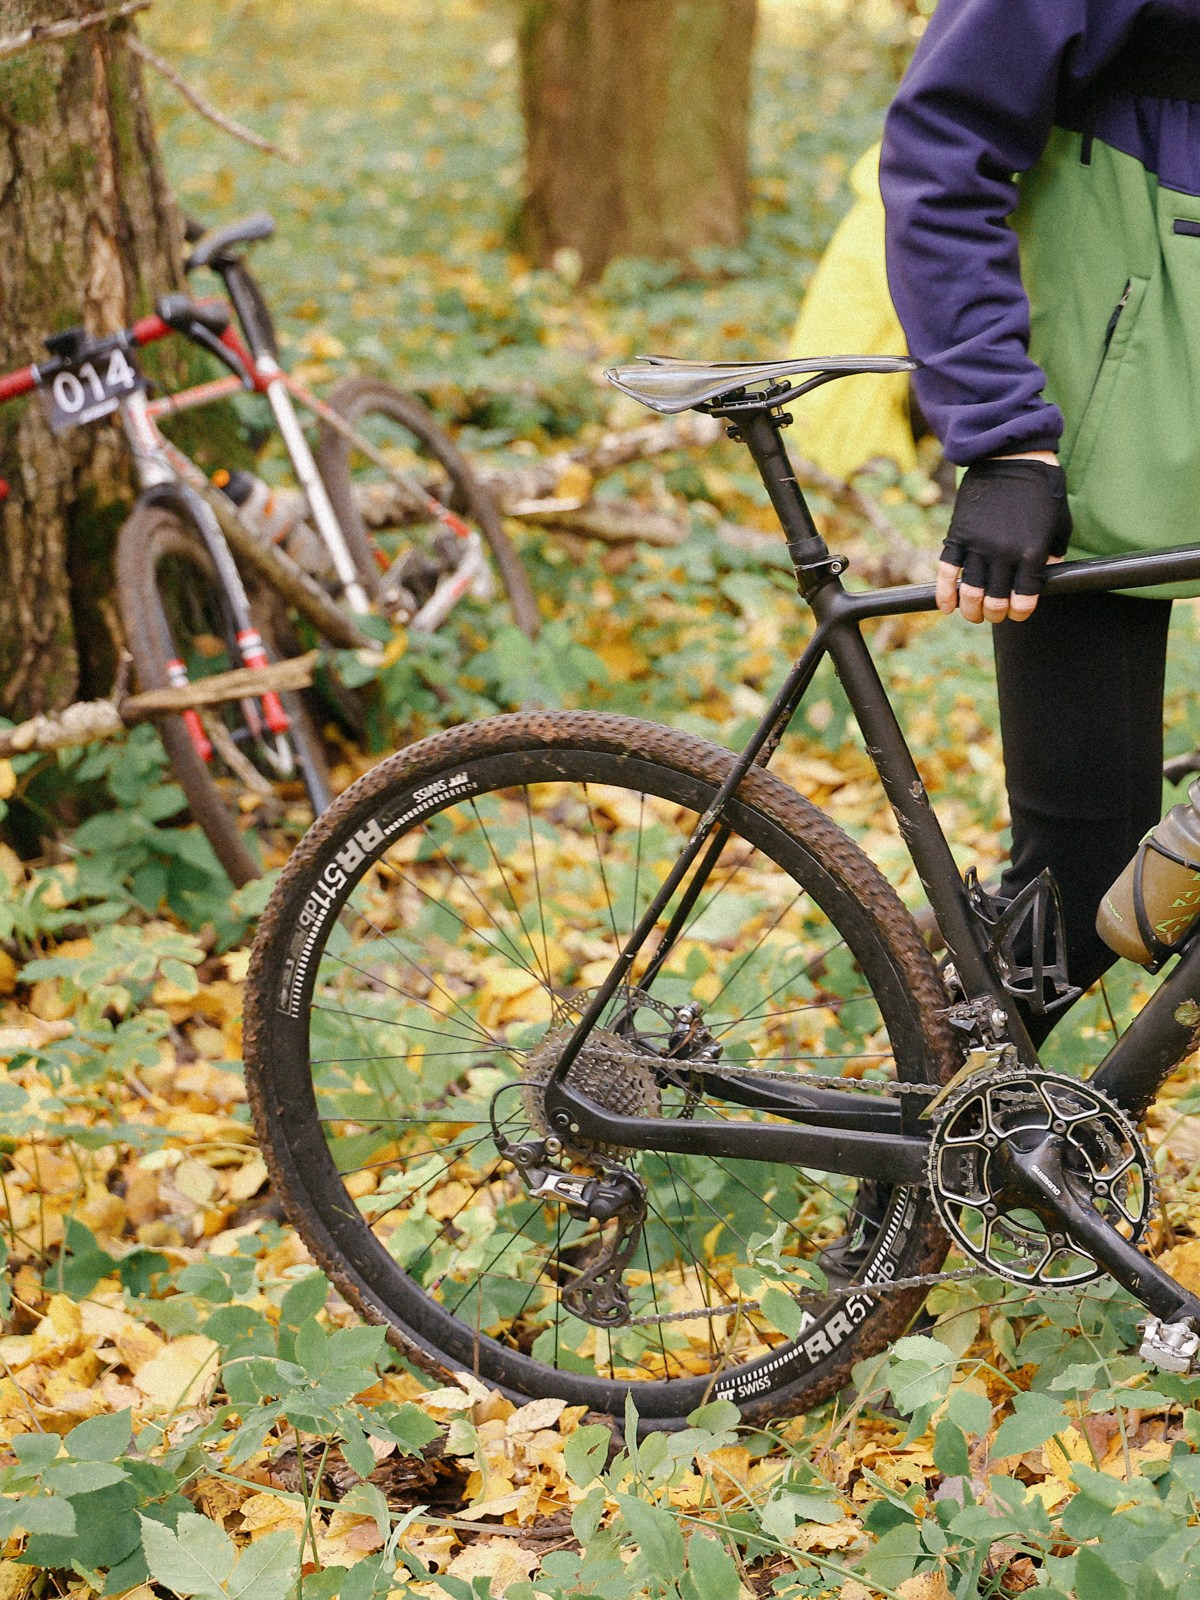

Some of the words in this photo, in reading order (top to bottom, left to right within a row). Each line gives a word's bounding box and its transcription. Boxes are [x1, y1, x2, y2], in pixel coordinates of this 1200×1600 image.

[52, 348, 135, 413] 014
[1030, 1164, 1061, 1195] SHIMANO
[737, 1375, 771, 1398] SWISS
